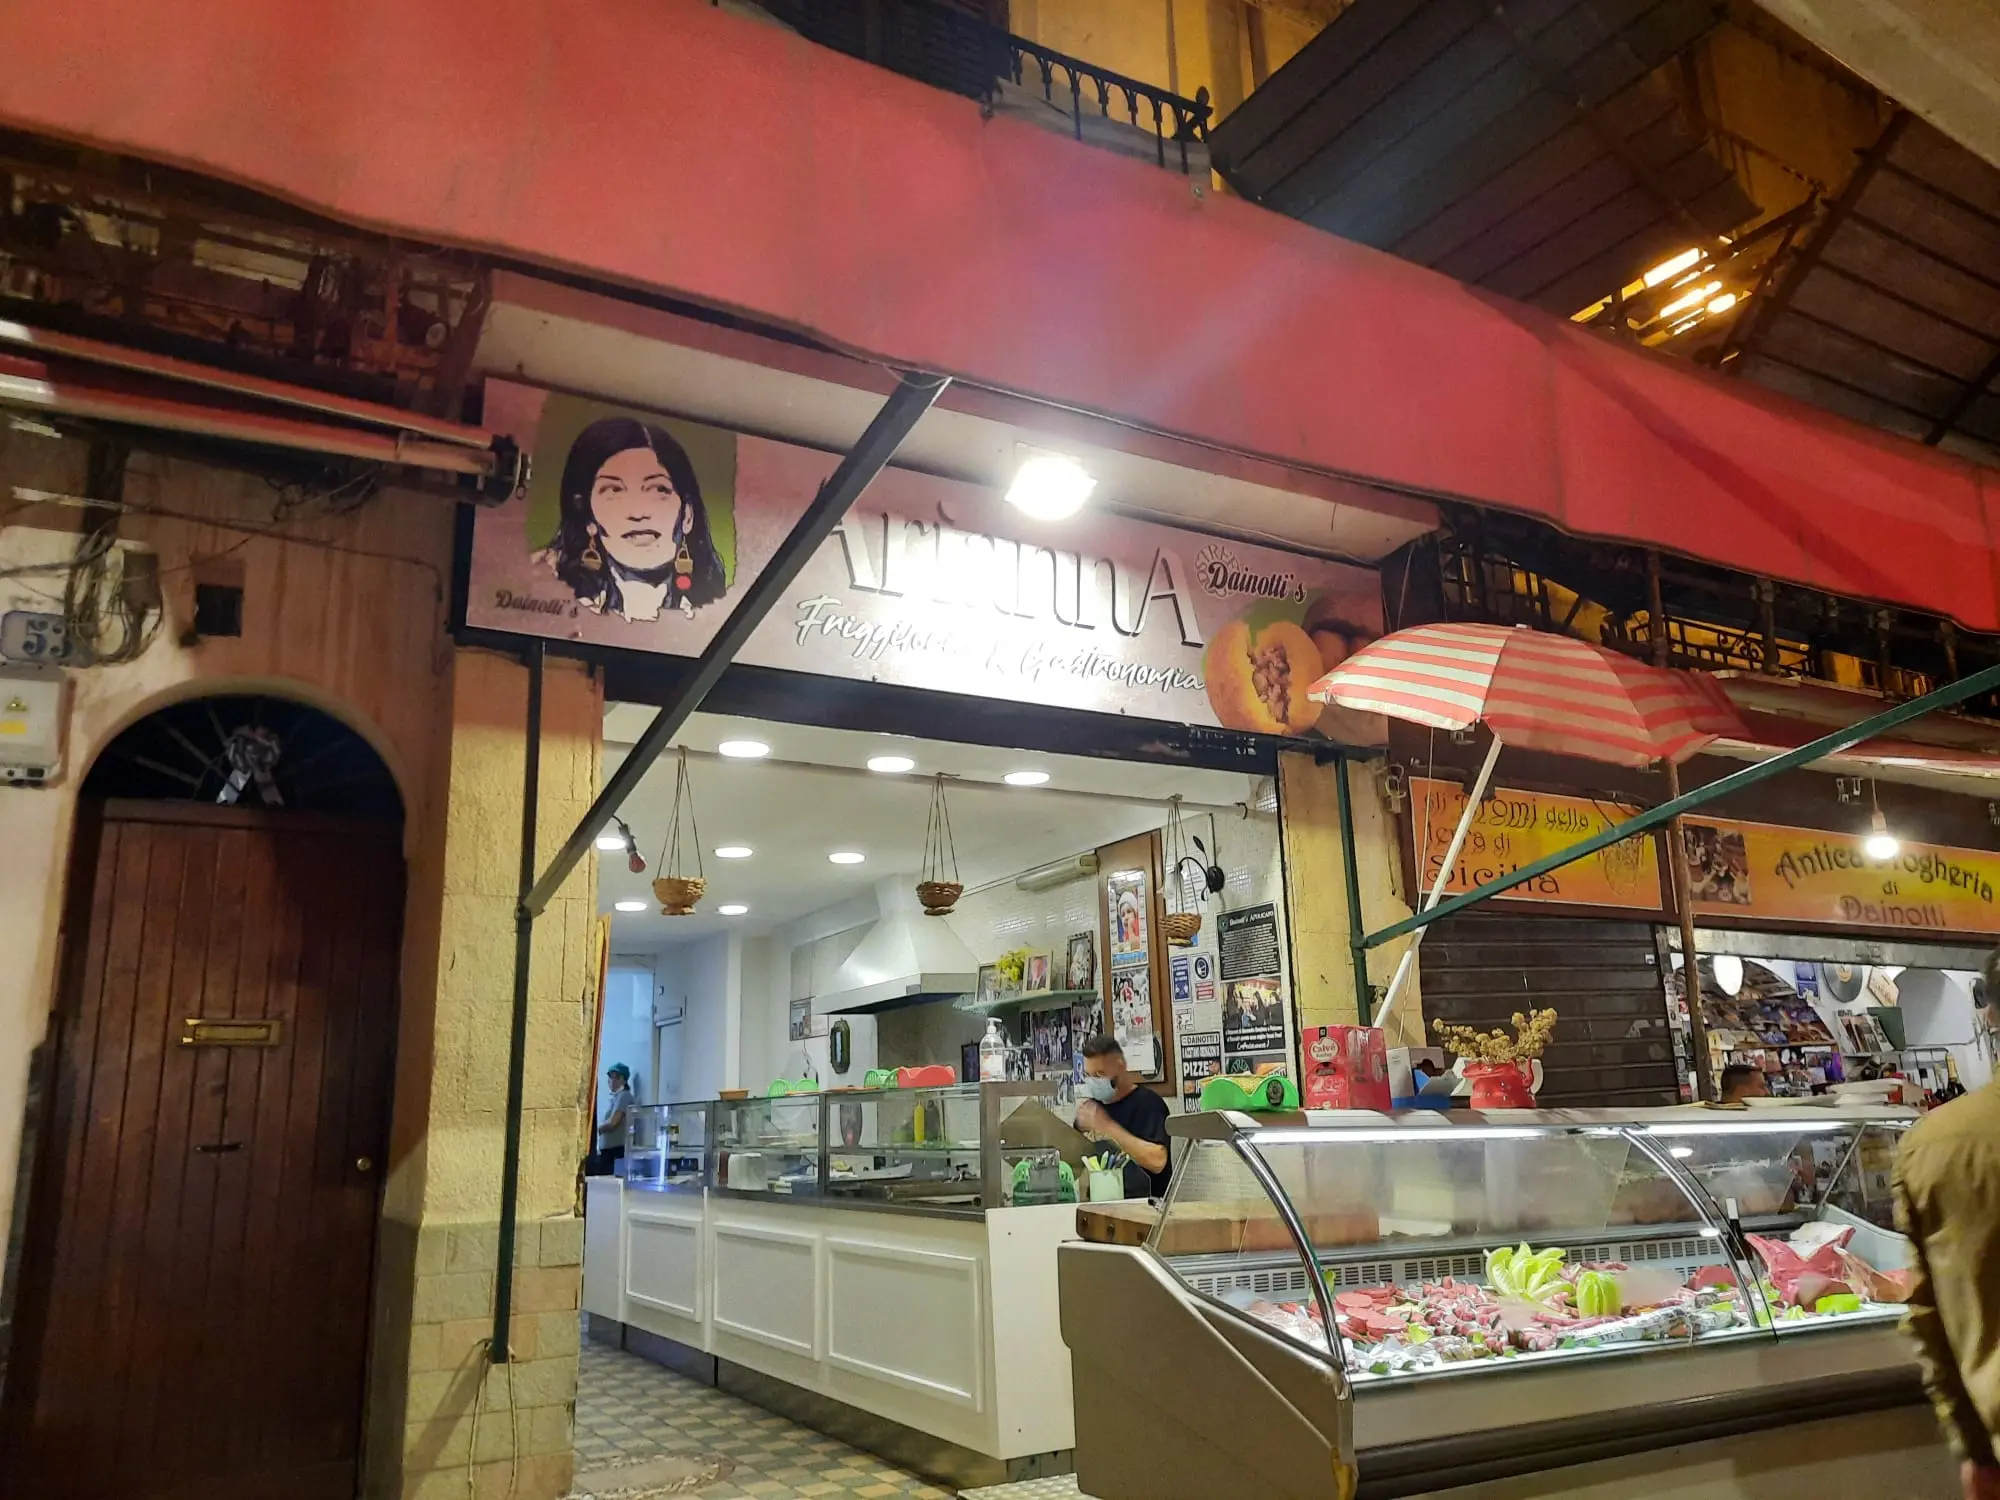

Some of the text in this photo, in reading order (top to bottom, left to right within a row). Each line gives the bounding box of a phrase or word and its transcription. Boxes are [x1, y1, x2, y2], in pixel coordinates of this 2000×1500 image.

[795, 594, 962, 661] Friggitora
[1873, 848, 1993, 904] ogheria
[1882, 881, 1898, 896] di
[1183, 1060, 1210, 1077] PIZZE
